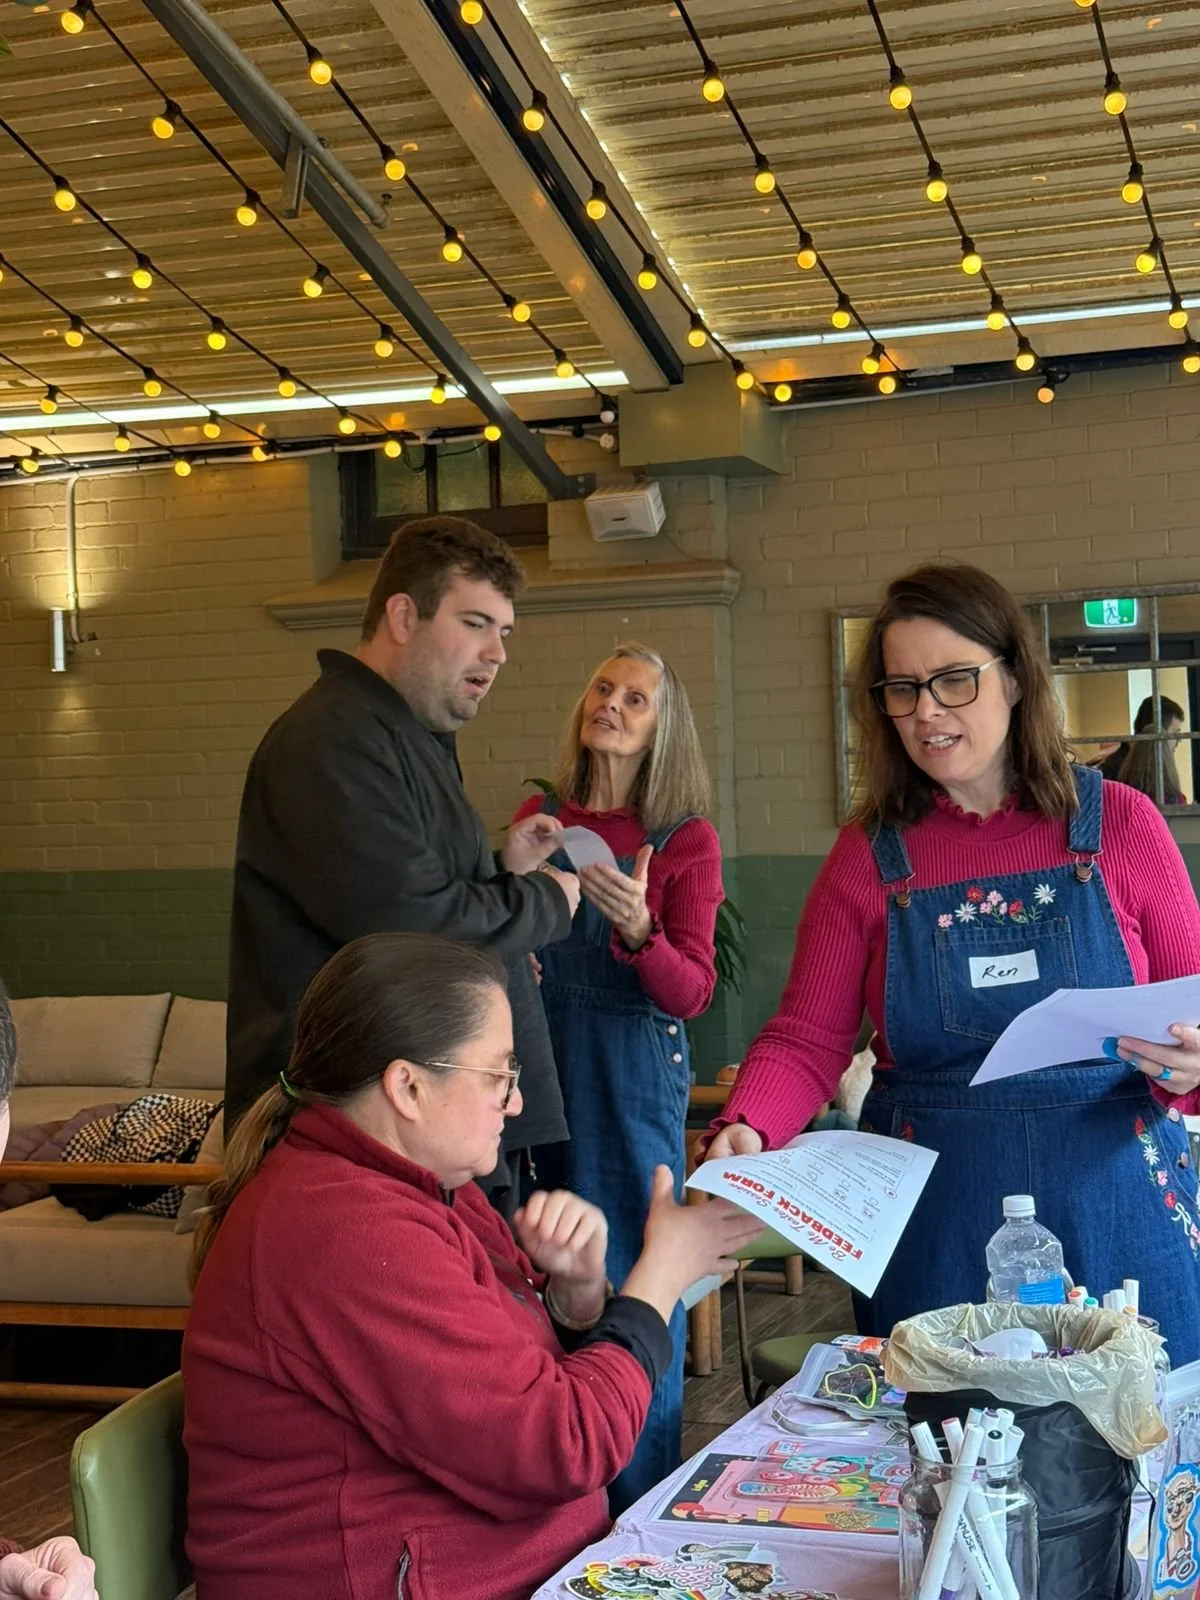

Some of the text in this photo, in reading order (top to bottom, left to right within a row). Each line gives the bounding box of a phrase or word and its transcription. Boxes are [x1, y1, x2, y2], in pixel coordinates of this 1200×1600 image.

[982, 964, 1018, 979] Ren
[723, 1171, 776, 1200] FORM
[728, 1183, 772, 1207] Session
[772, 1206, 805, 1232] Taster
[777, 1196, 863, 1260] FEEDBACK
[808, 1230, 829, 1245] Me
[829, 1246, 846, 1261] Be
